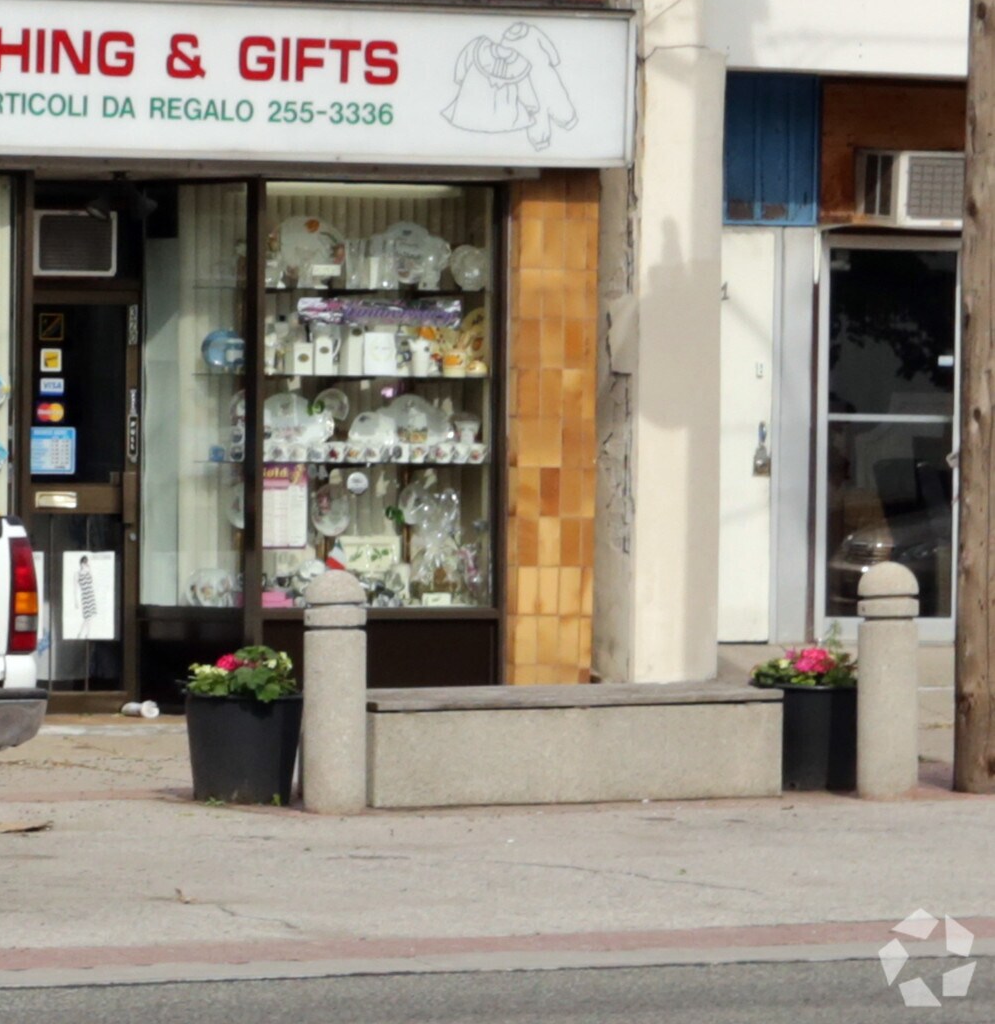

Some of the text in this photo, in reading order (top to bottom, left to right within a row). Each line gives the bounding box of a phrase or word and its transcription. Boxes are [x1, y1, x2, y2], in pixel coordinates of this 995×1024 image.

[166, 33, 206, 79] &
[239, 36, 399, 85] GIFTS
[102, 95, 136, 119] DA
[150, 97, 253, 122] REGALO
[268, 101, 394, 125] 255-3336
[42, 381, 62, 390] VISA
